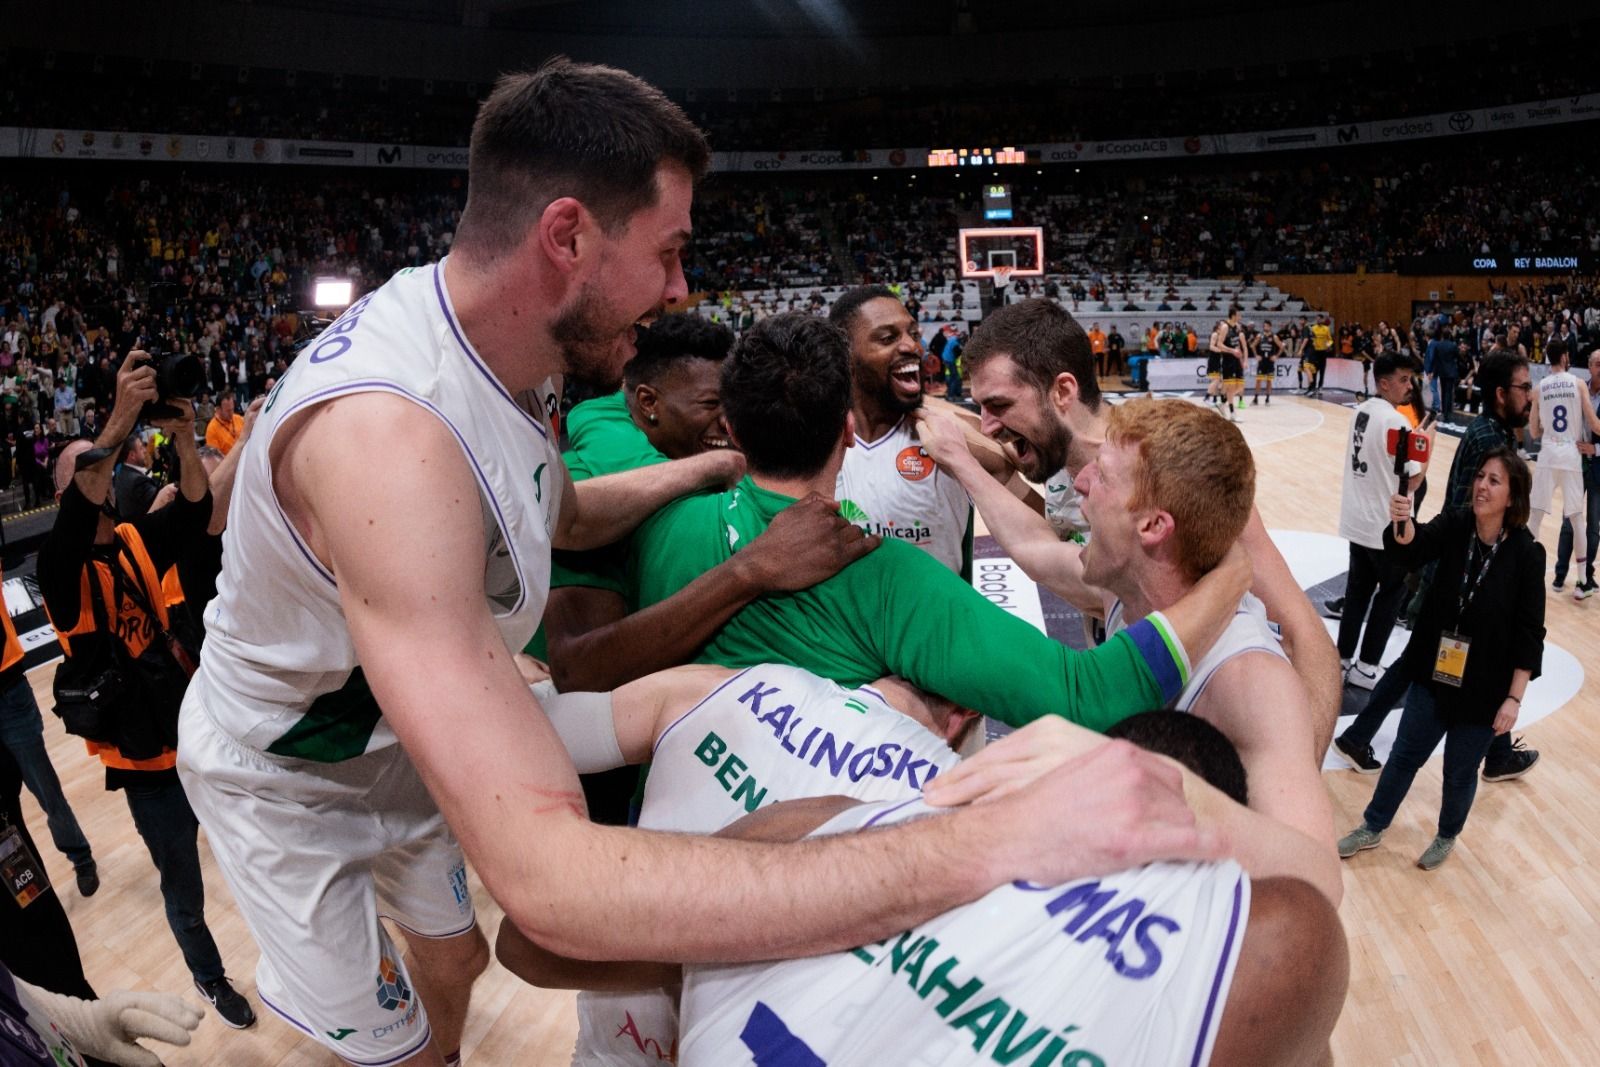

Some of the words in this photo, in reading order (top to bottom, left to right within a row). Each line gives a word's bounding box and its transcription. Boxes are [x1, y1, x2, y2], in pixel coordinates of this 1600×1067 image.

[1383, 122, 1432, 137] endesa
[1096, 140, 1168, 155] #CopaACB
[1473, 259, 1497, 268] COPA
[1515, 258, 1530, 268] REY
[1535, 257, 1578, 268] BADALON
[1276, 364, 1293, 377] EY
[1552, 404, 1568, 433] 8
[866, 520, 931, 541] Unicaja
[737, 681, 939, 791] KALINOSKI
[694, 731, 780, 813] BEN
[15, 869, 34, 889] ACB
[1012, 879, 1181, 980] MAS
